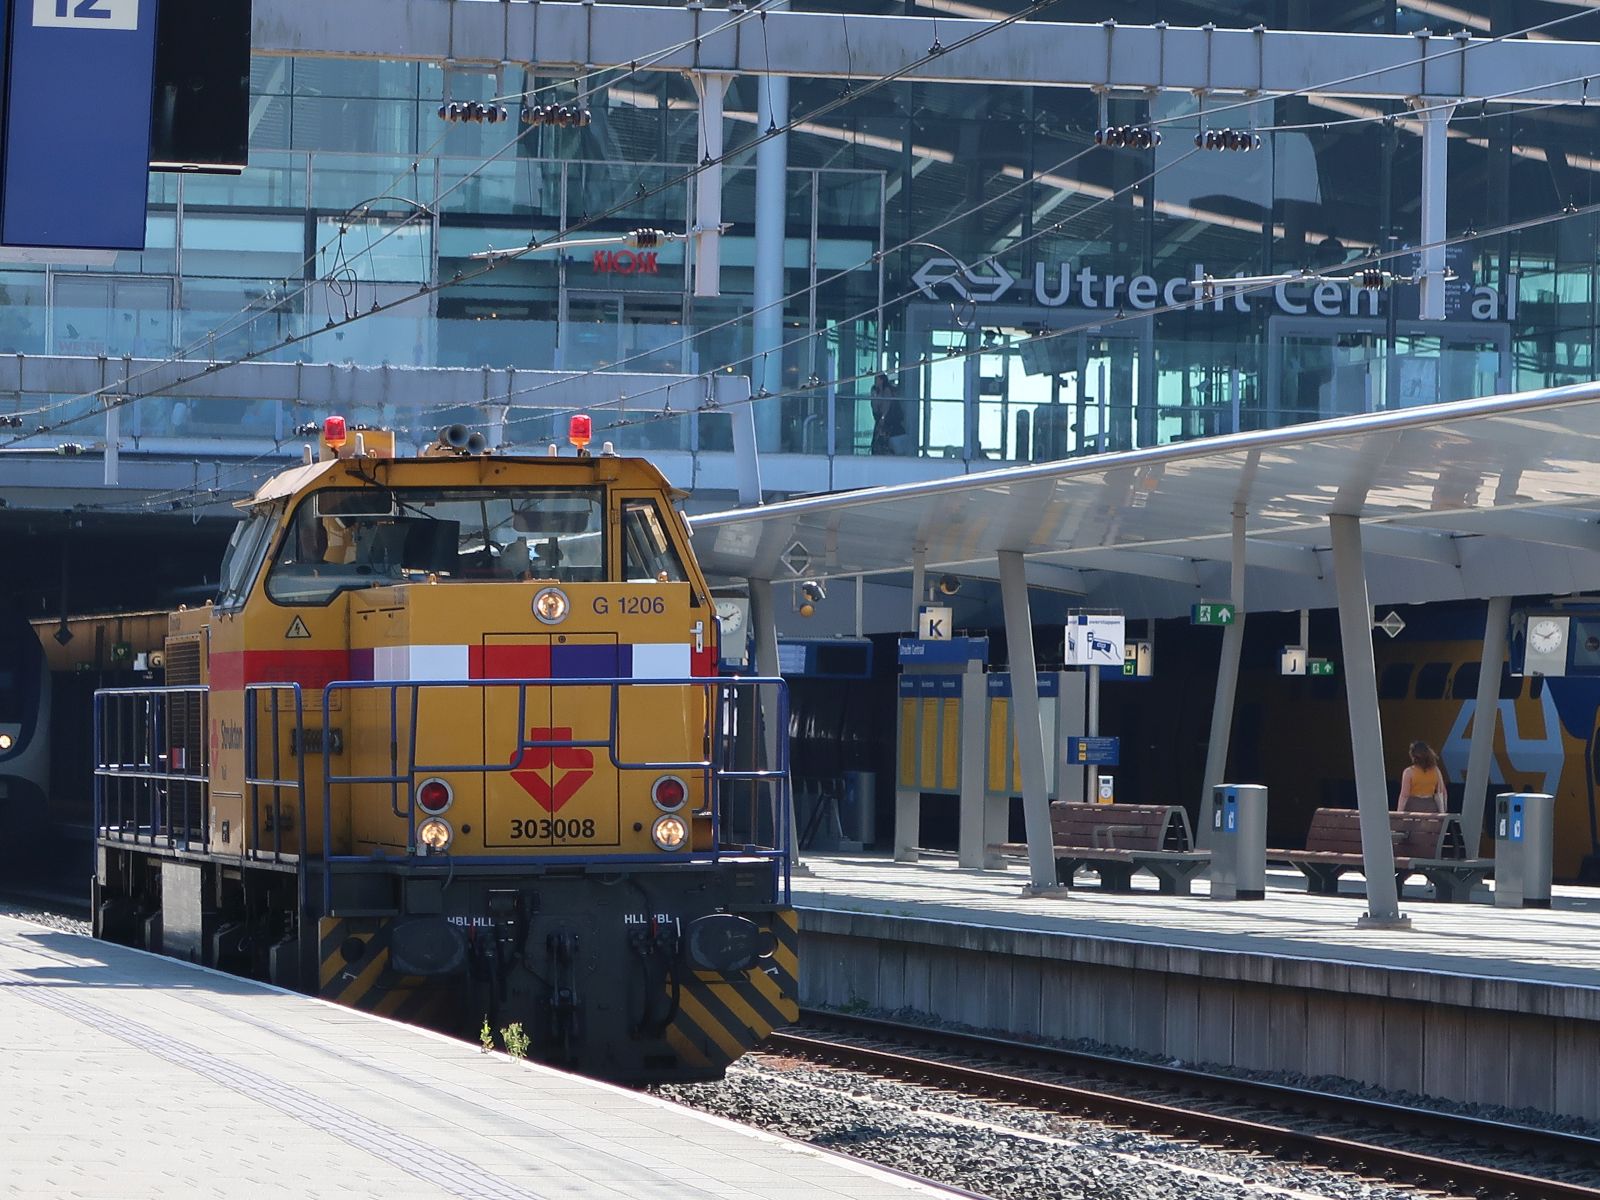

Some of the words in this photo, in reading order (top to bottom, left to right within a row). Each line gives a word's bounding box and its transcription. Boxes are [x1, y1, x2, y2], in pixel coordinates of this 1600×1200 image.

[593, 250, 658, 275] KIOSK
[1035, 261, 1251, 311] Utrecht
[1274, 269, 1516, 321] Cenal
[592, 596, 609, 614] G
[618, 596, 665, 614] 1206
[929, 619, 944, 637] K
[1290, 658, 1297, 673] J
[509, 818, 596, 839] 303008
[472, 916, 496, 927] HLL
[624, 913, 648, 924] HLL
